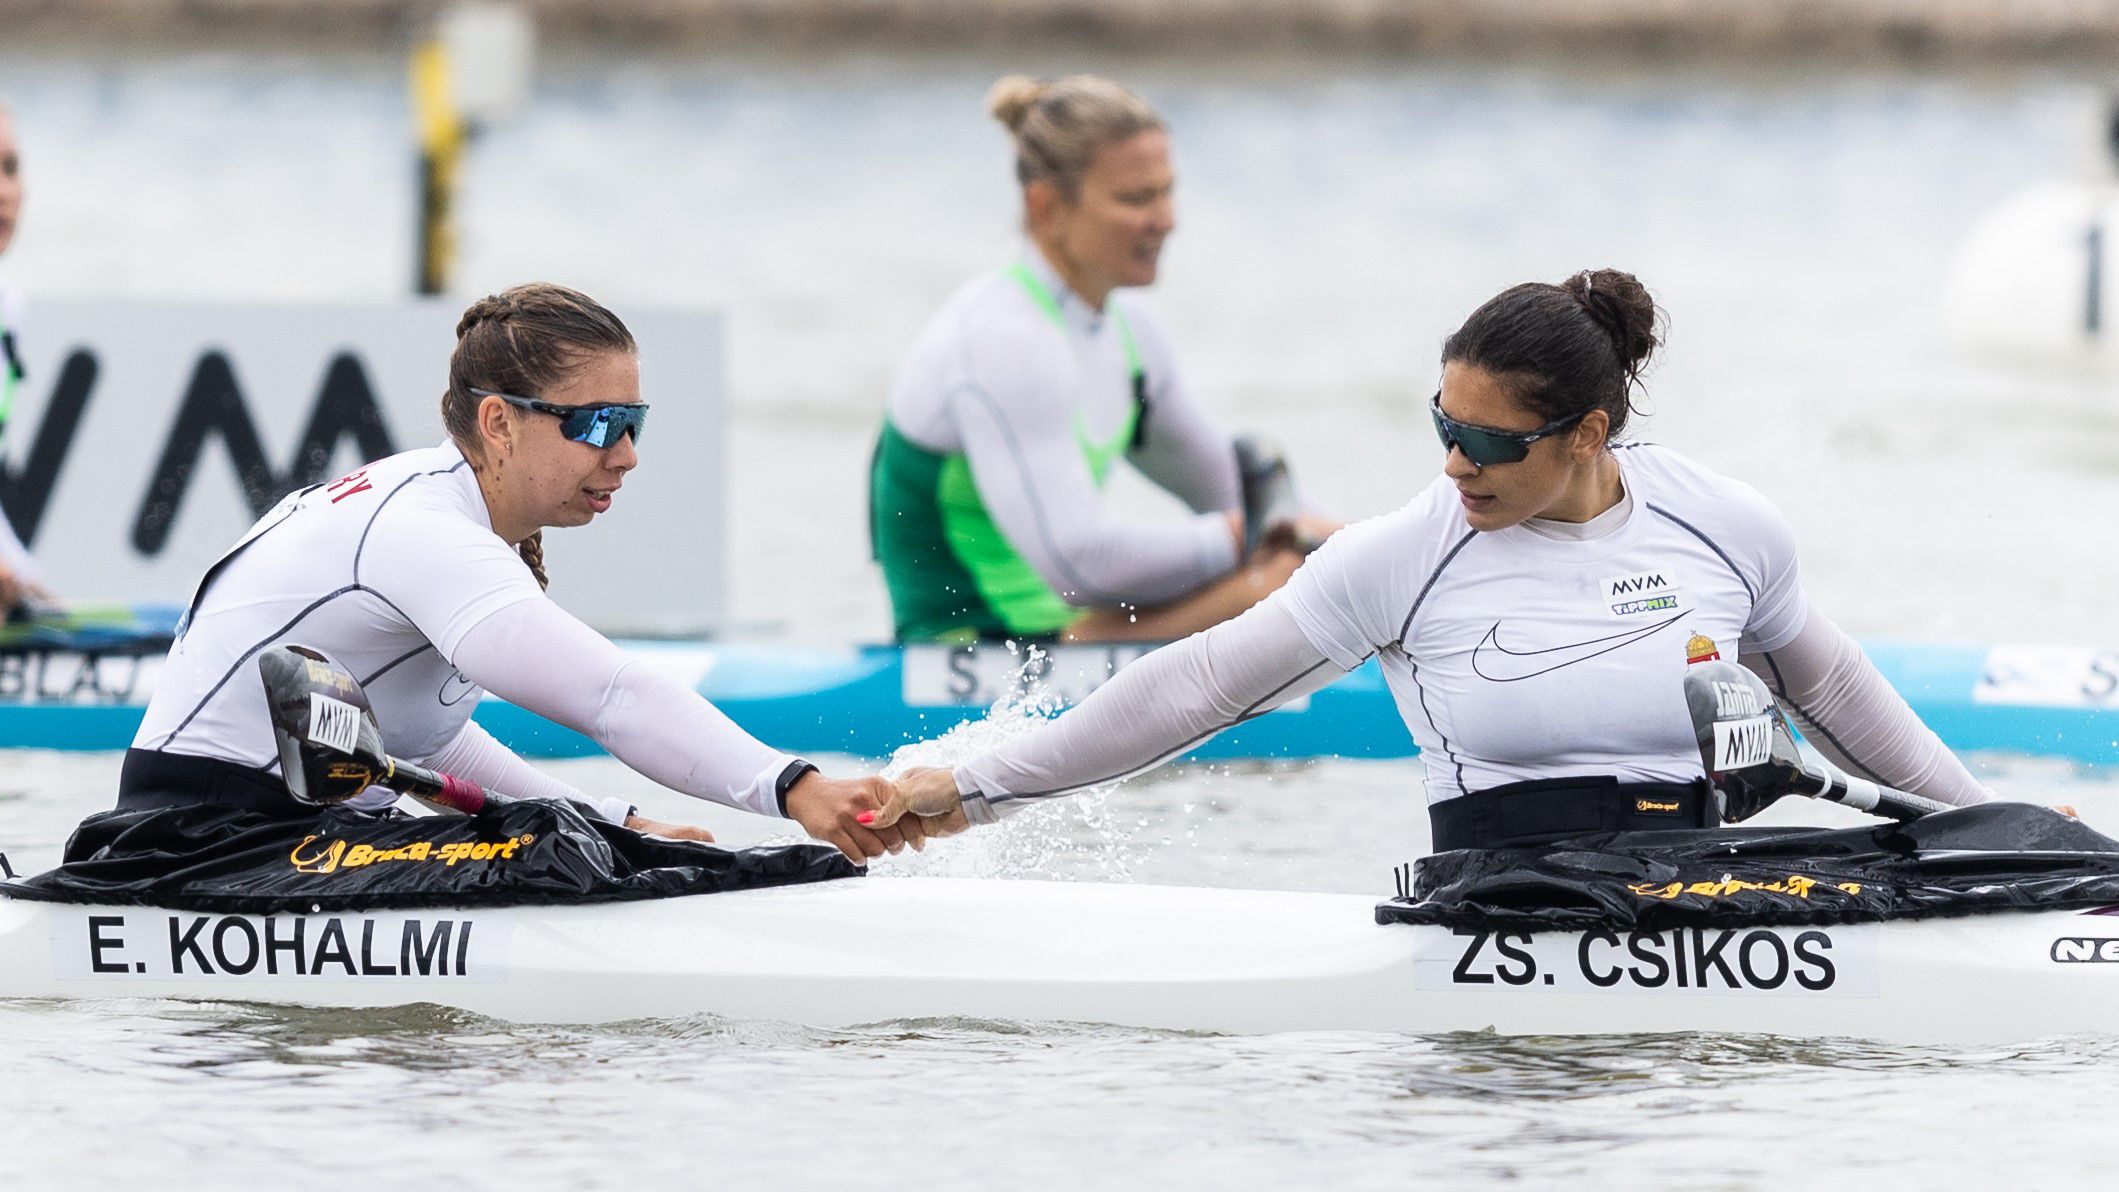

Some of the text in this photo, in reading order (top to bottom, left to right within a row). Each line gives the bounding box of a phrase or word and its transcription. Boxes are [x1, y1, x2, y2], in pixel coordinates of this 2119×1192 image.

[1612, 574, 1667, 596] MVM
[314, 701, 354, 750] MVM
[1725, 721, 1768, 767] MVM
[88, 915, 474, 977] E. KOHALMI
[1452, 928, 1837, 991] ZS. CSIKOS
